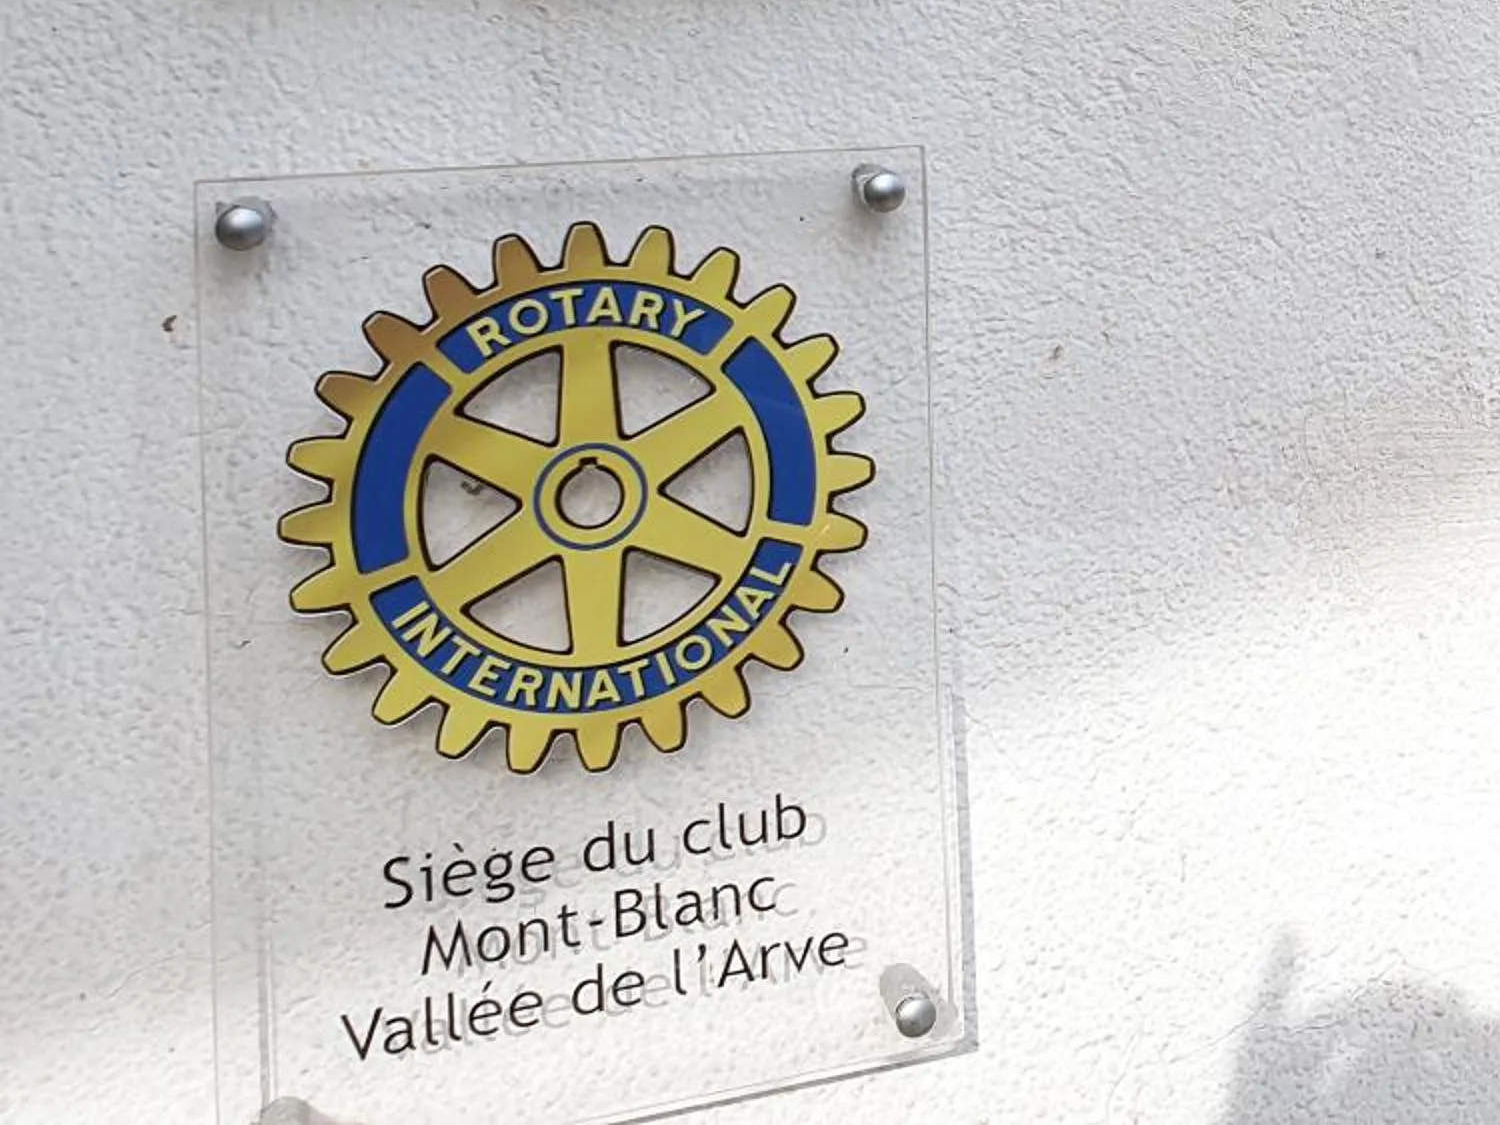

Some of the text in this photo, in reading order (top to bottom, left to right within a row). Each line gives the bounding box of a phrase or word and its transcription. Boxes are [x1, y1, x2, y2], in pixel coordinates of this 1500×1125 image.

[466, 285, 708, 359] ROTARY
[391, 558, 794, 710] INTERNATIONAL
[382, 793, 808, 910] Siège du club
[420, 875, 778, 977] Mont-Blanc
[340, 928, 850, 1061] Vallée de l'Arve
